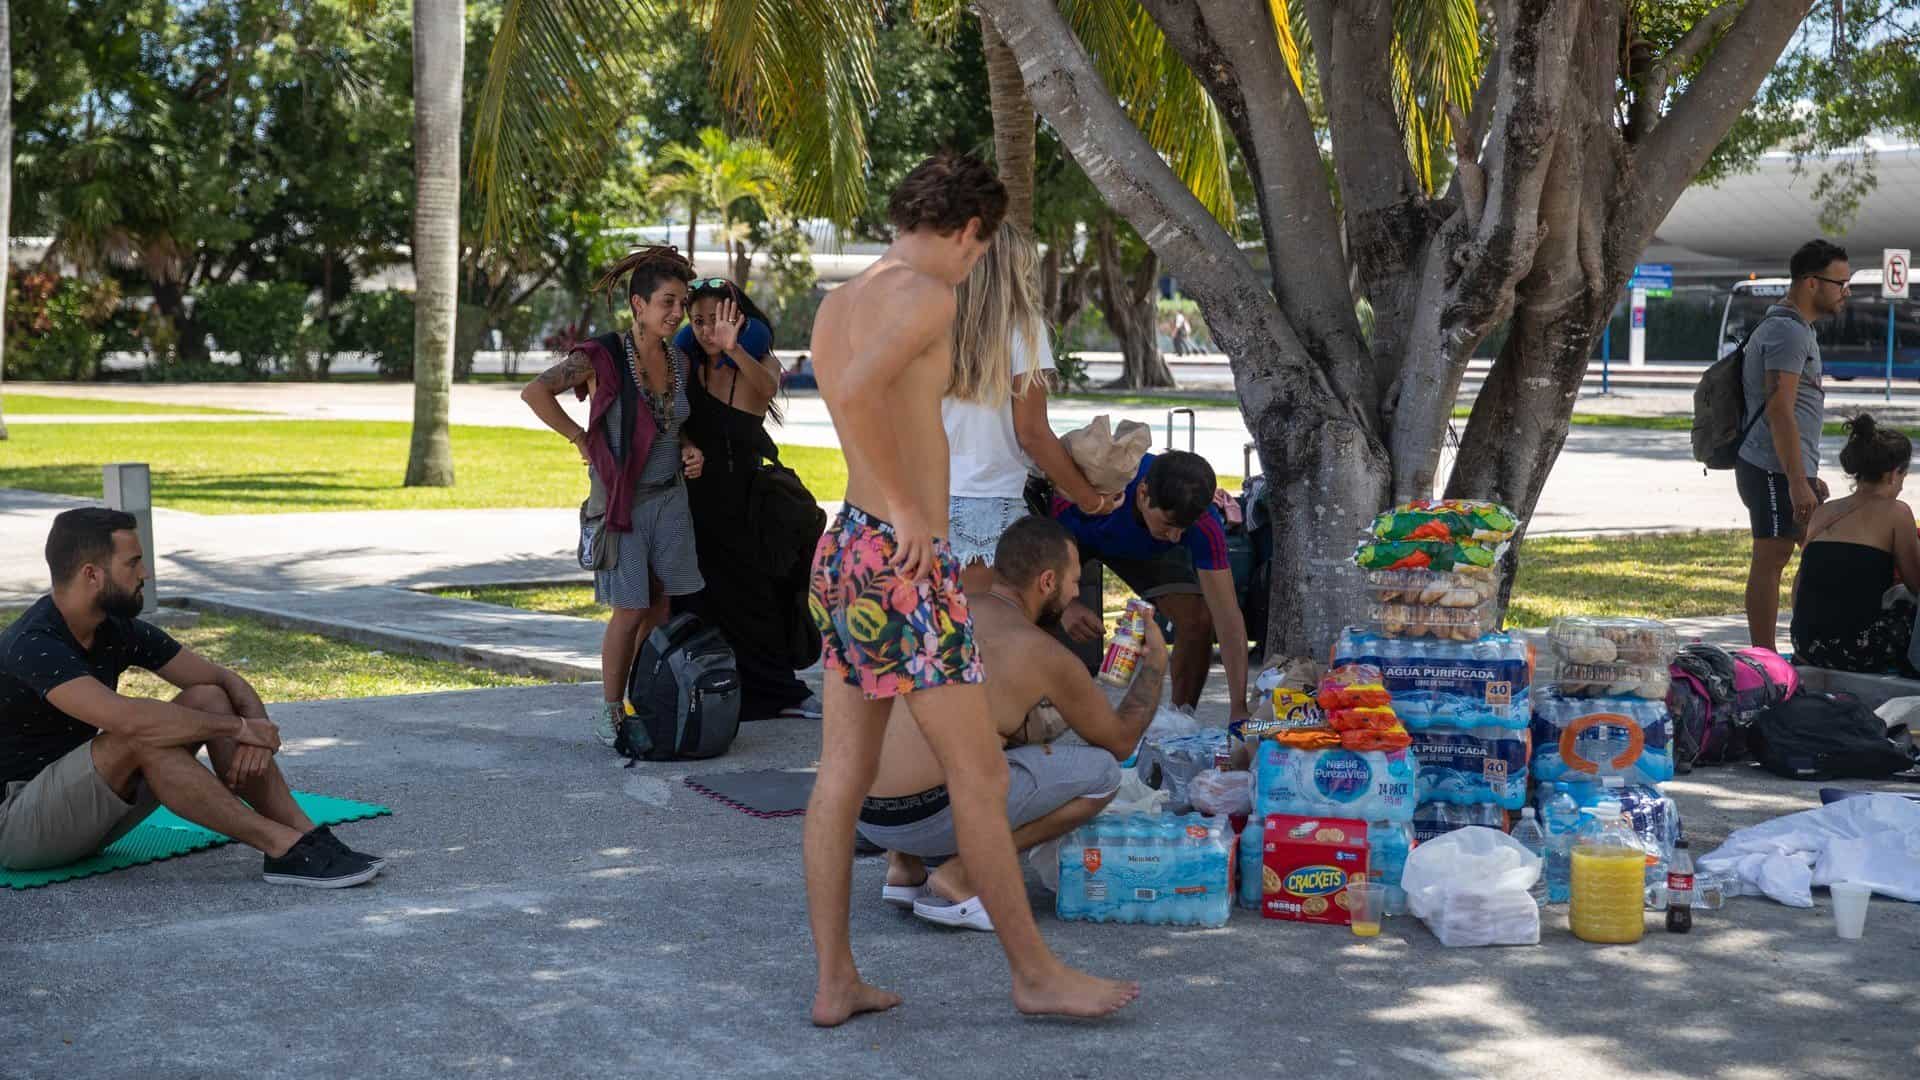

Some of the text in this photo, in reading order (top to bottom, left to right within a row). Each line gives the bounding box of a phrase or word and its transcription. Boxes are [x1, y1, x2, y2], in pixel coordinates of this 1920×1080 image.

[849, 508, 867, 525] FILA
[1386, 667, 1495, 679] AGUA PURIFICADA
[1489, 685, 1507, 695] 40
[1423, 745, 1488, 756] PURIFICADA
[1488, 763, 1504, 772] 40
[1379, 783, 1408, 796] 24 PACK
[1288, 871, 1342, 891] CRACKETS
